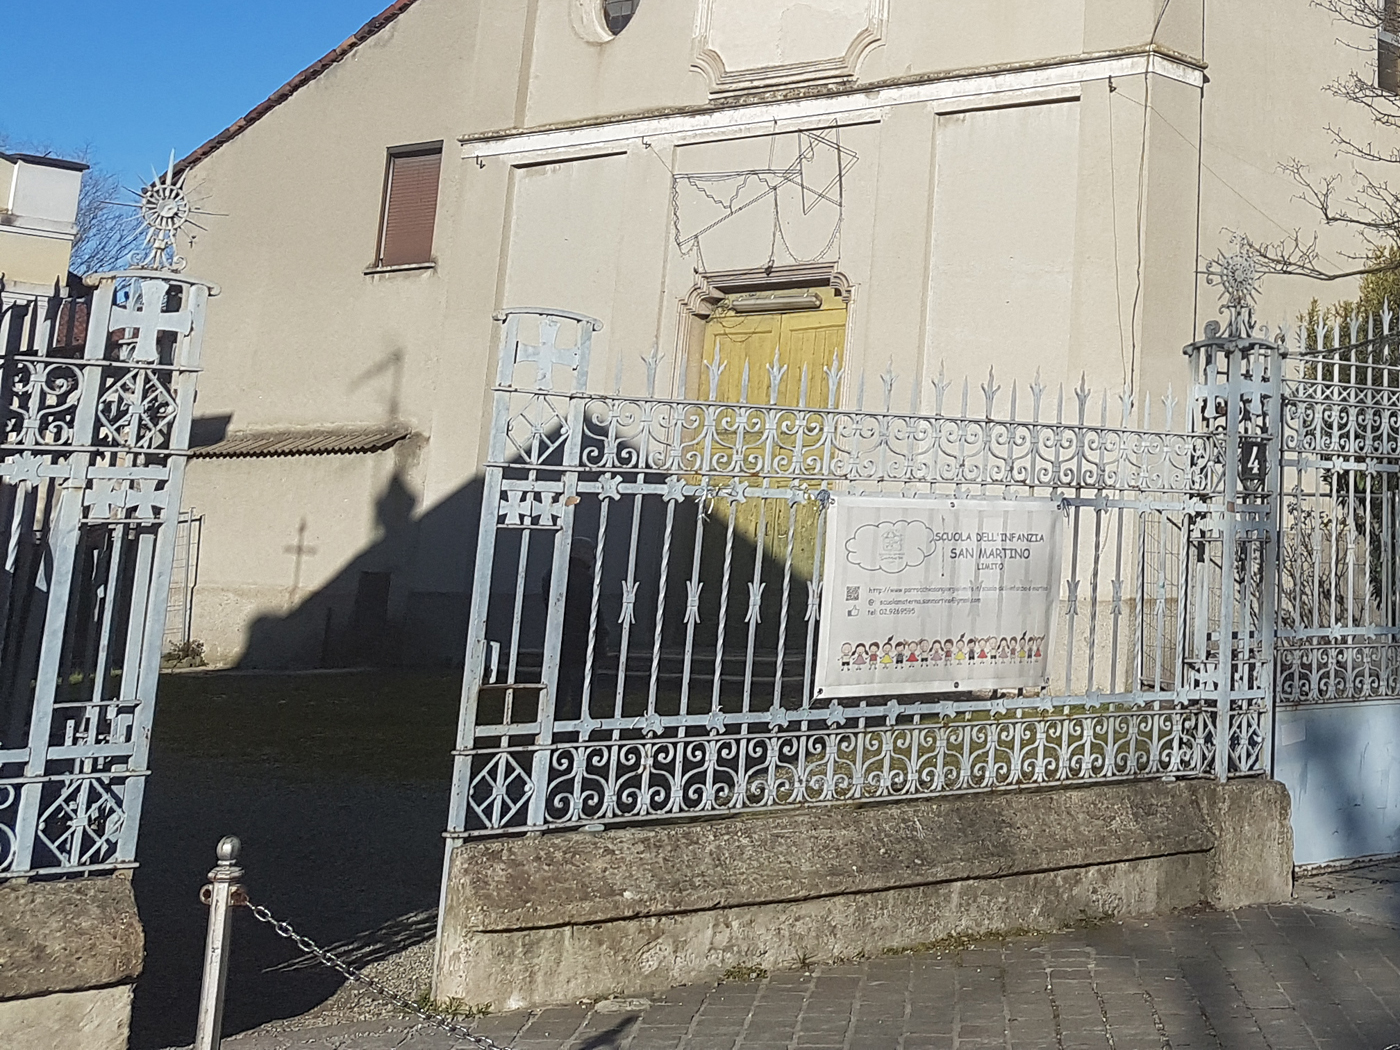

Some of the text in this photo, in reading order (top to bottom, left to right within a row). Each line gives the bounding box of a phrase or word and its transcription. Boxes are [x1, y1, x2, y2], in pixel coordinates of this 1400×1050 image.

[1247, 446, 1260, 474] 4
[934, 532, 1045, 543] SCUOLA DELL'INFANZIA
[949, 547, 1031, 559] SAN MARTINO
[977, 562, 1004, 571] LIMITO
